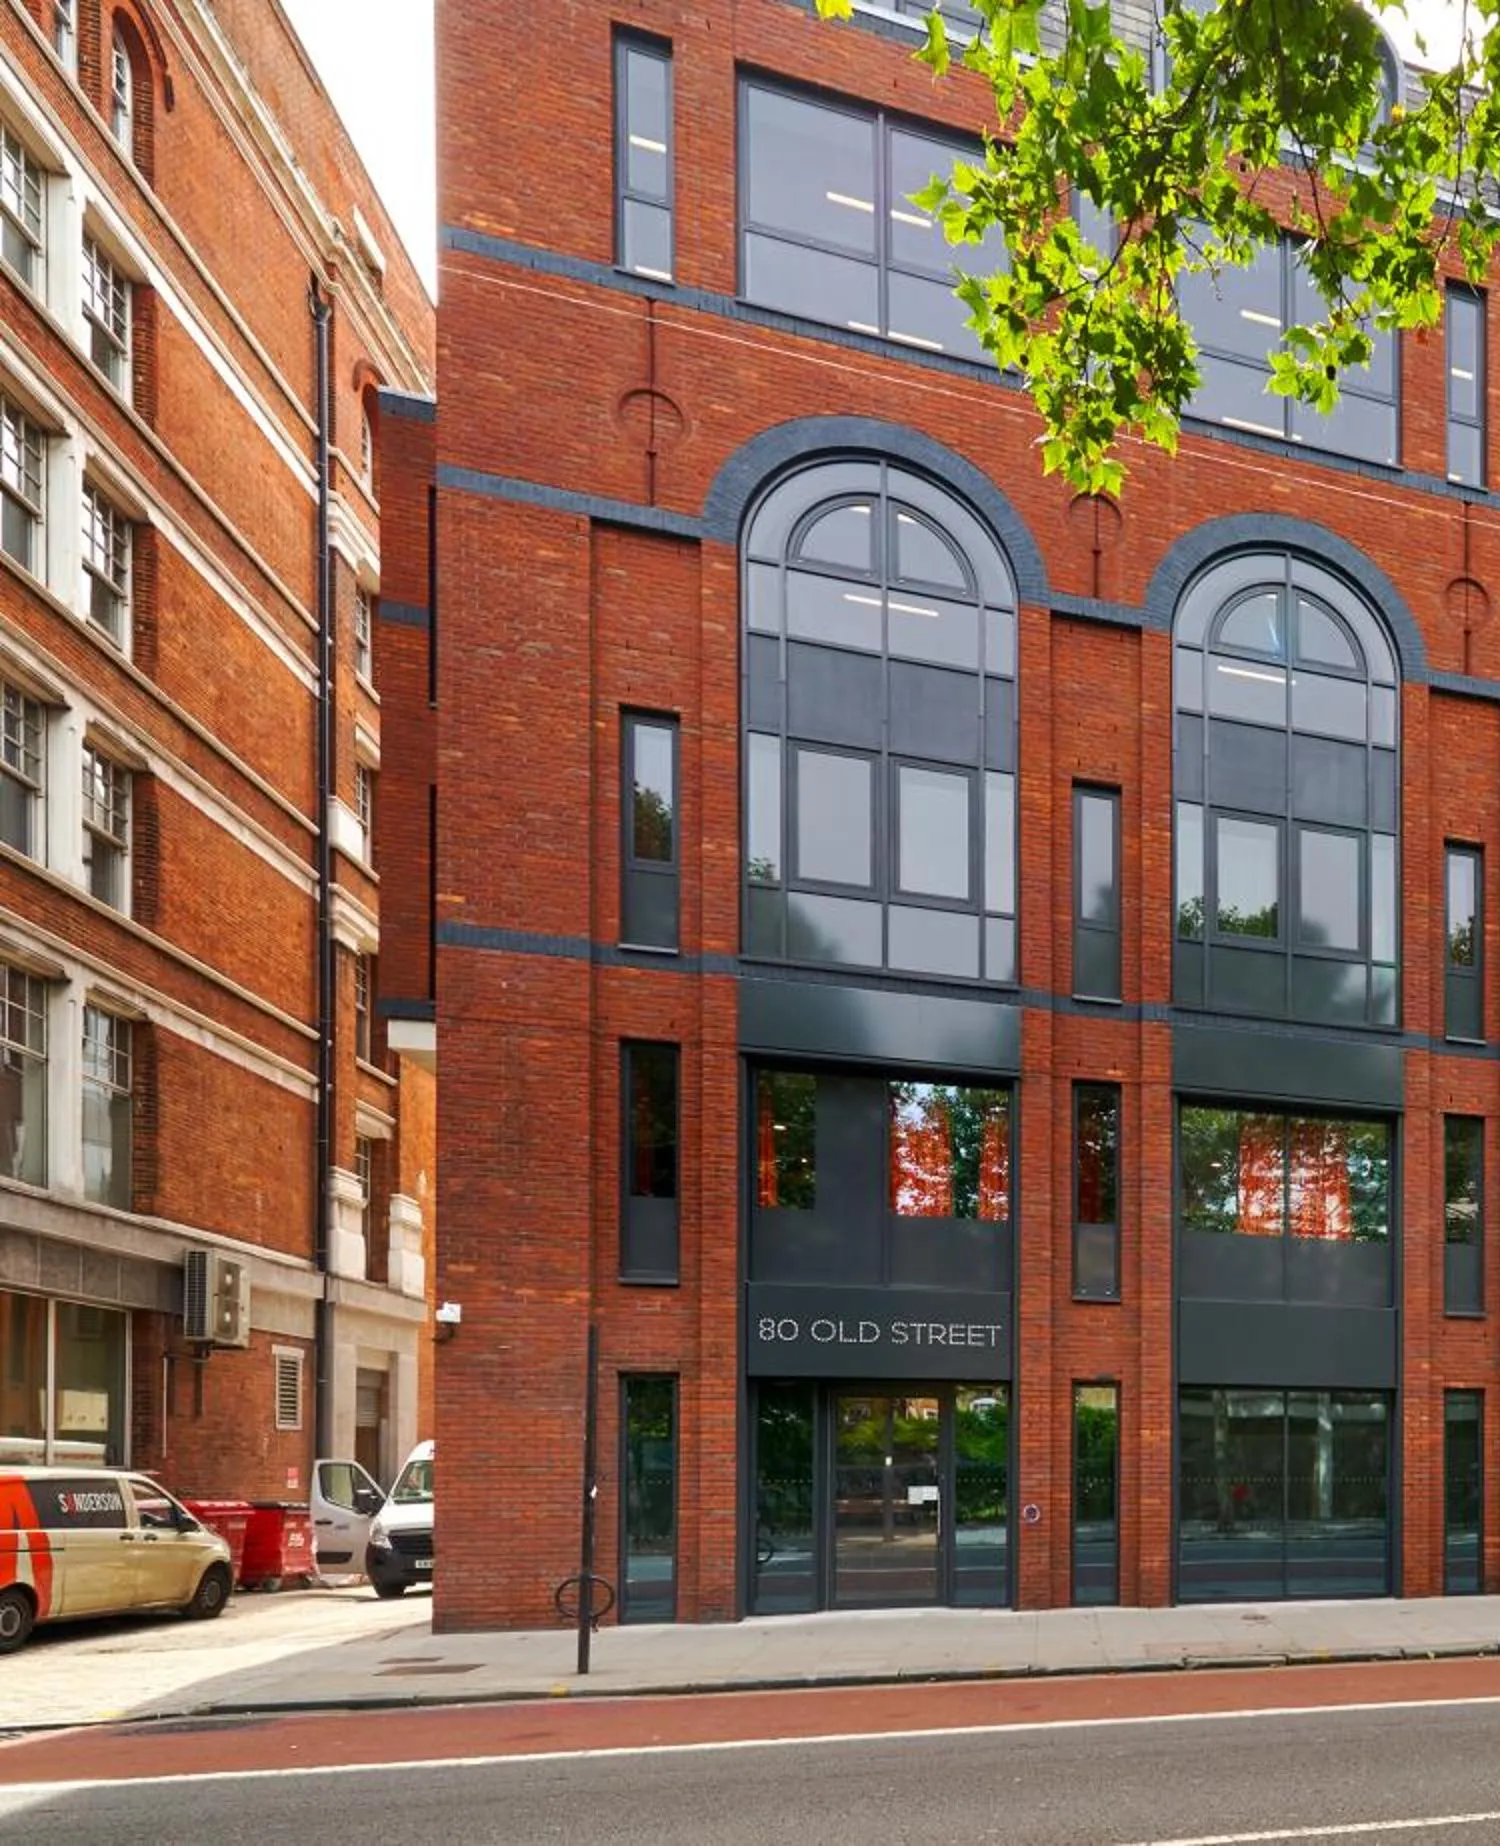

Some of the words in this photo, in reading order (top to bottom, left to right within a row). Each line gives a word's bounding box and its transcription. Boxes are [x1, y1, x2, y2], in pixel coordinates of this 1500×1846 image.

[758, 1317, 799, 1342] 80
[810, 1319, 881, 1344] OLD
[890, 1321, 1002, 1347] STREET
[58, 1490, 123, 1516] SANDERSON
